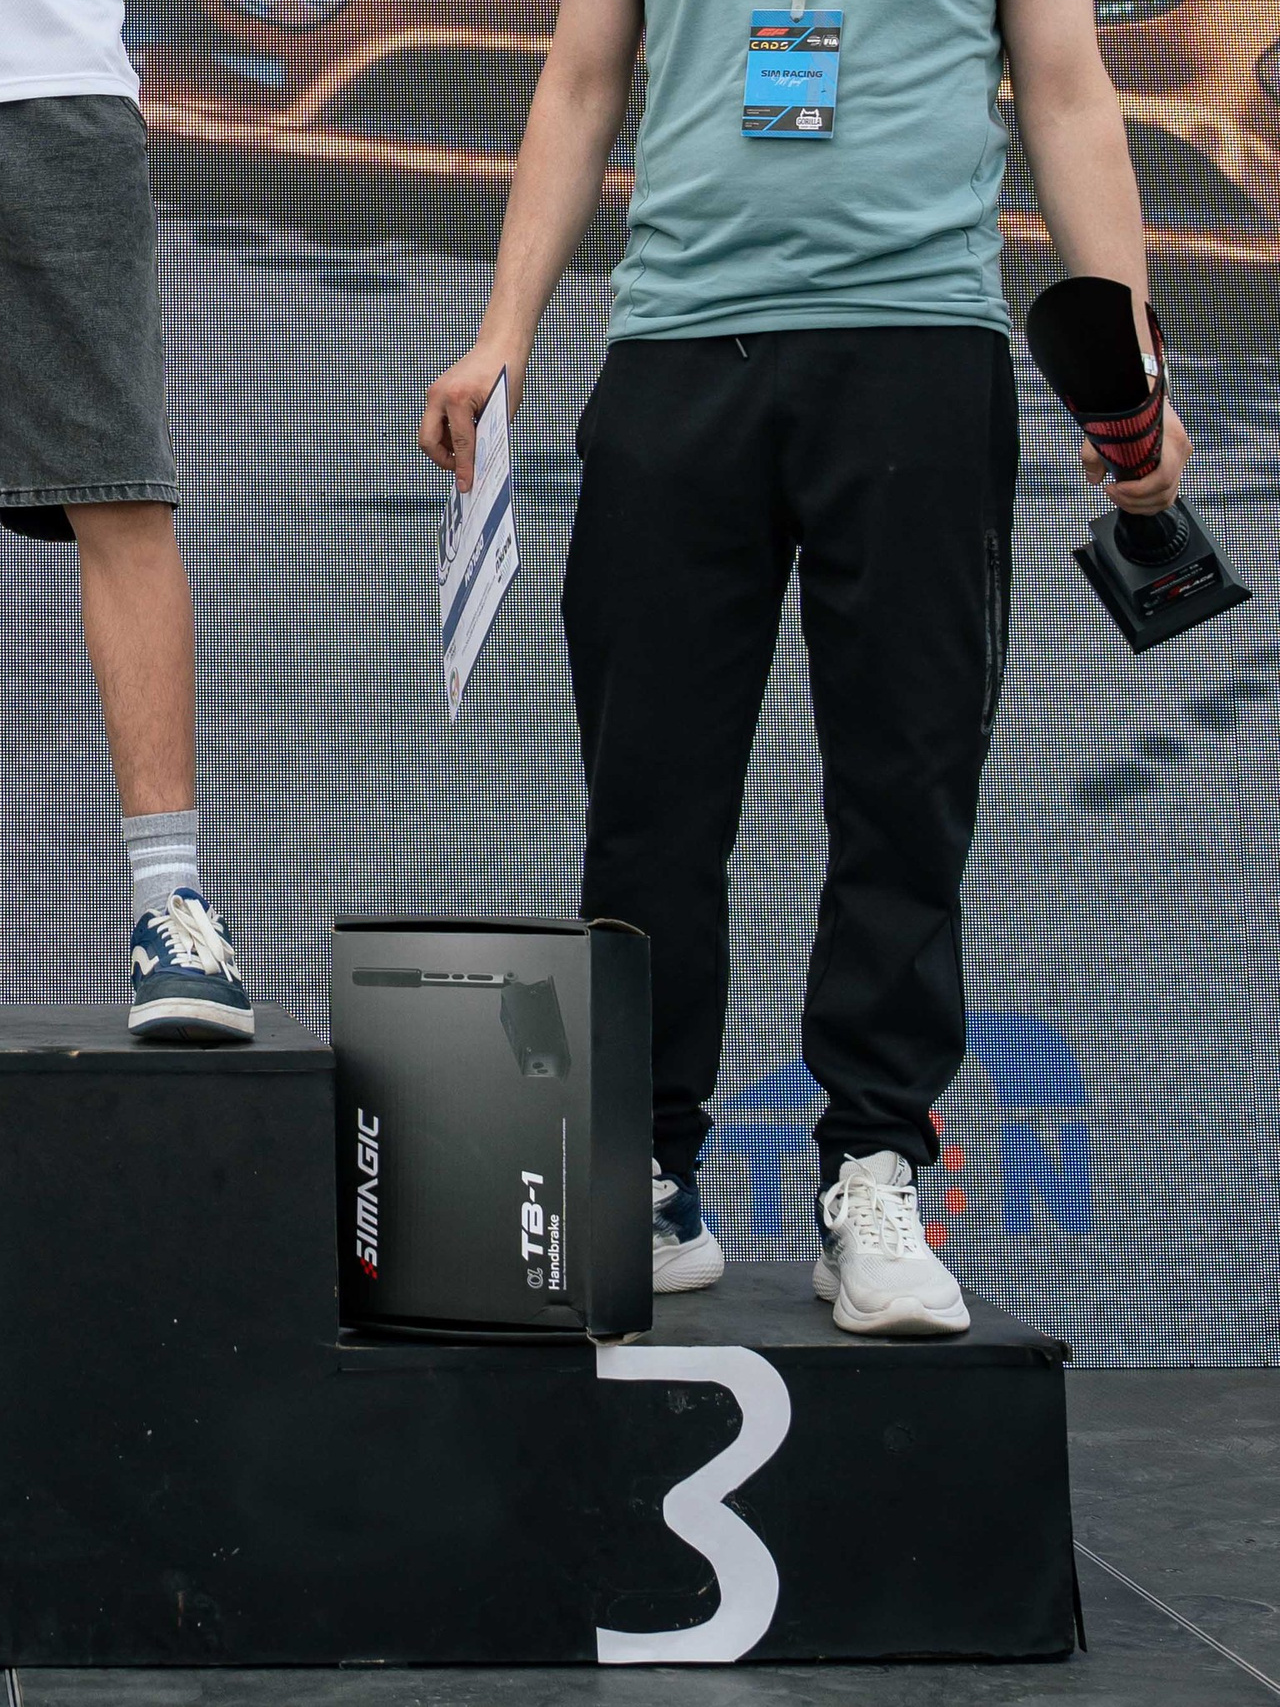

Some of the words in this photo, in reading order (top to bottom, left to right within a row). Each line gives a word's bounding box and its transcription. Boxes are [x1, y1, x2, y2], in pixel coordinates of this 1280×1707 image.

[751, 41, 789, 50] CADS
[760, 69, 780, 78] SIM
[782, 70, 823, 78] RACING
[356, 1108, 380, 1279] SIMAGIC
[521, 1170, 544, 1261] TB-1
[548, 1213, 560, 1291] Handbrake
[597, 1346, 791, 1663] 3
